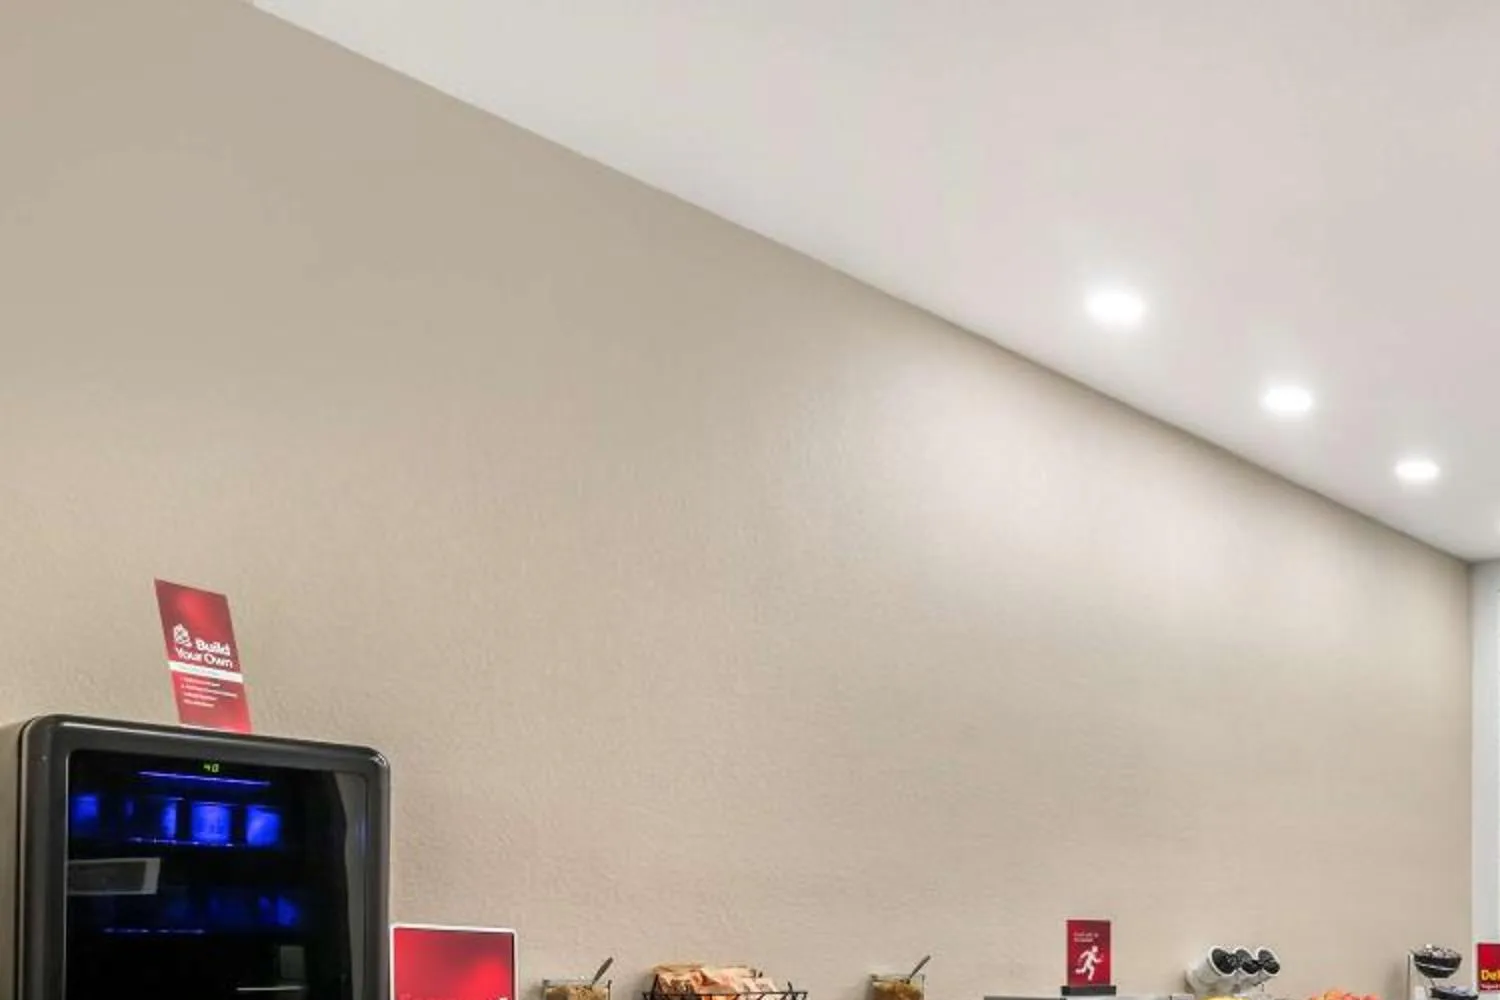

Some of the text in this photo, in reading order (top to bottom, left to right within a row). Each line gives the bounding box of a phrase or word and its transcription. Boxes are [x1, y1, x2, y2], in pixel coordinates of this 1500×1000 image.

[195, 638, 231, 656] Build
[175, 648, 233, 668] Your Own
